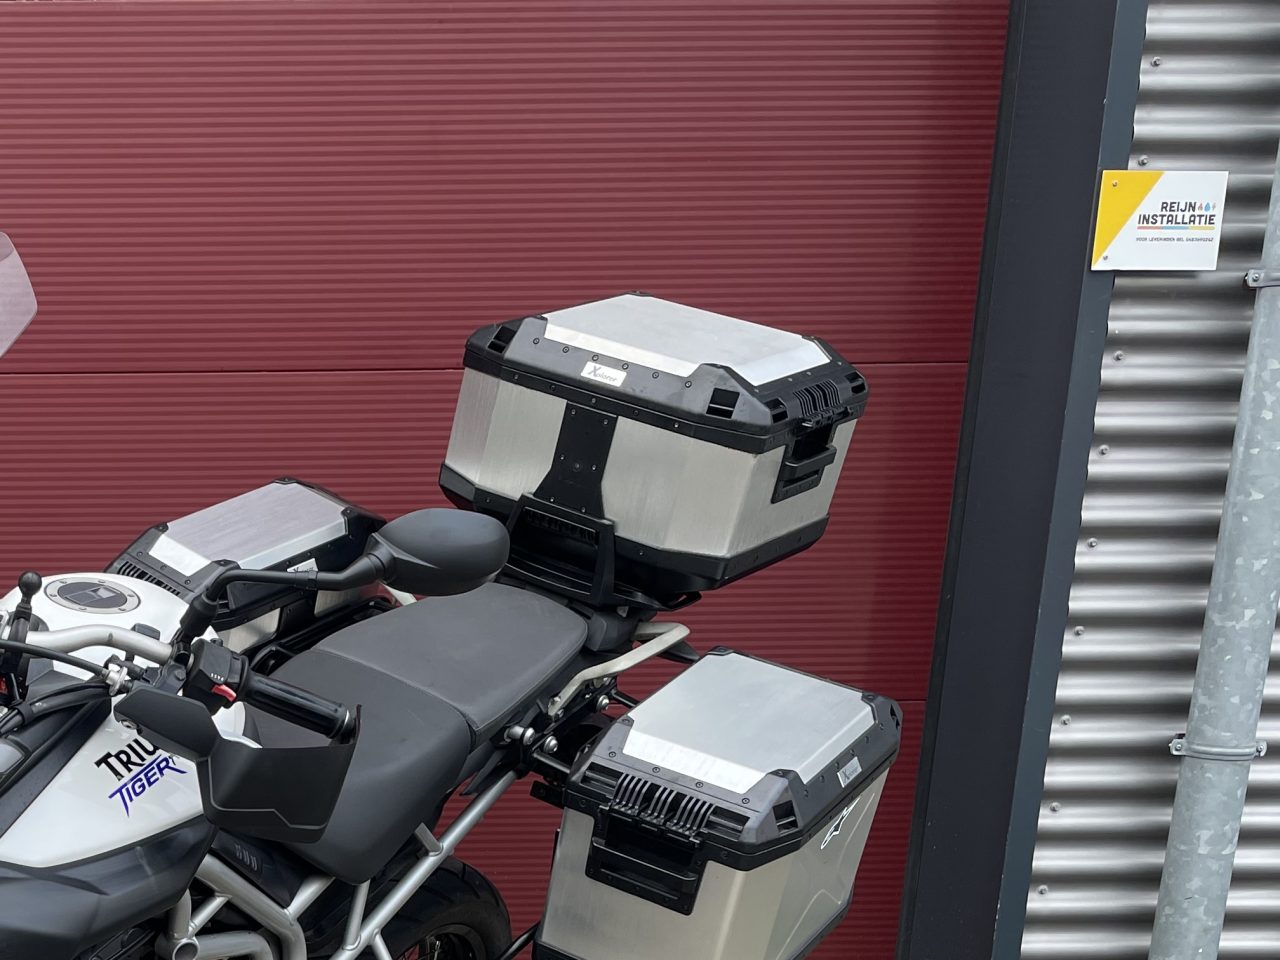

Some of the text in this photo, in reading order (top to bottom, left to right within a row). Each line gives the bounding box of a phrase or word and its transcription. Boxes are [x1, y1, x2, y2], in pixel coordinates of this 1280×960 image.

[1137, 214, 1216, 225] INSTALLATIE
[1160, 201, 1197, 213] REIJN
[94, 738, 166, 781] TRIU
[108, 754, 187, 818] TIGER
